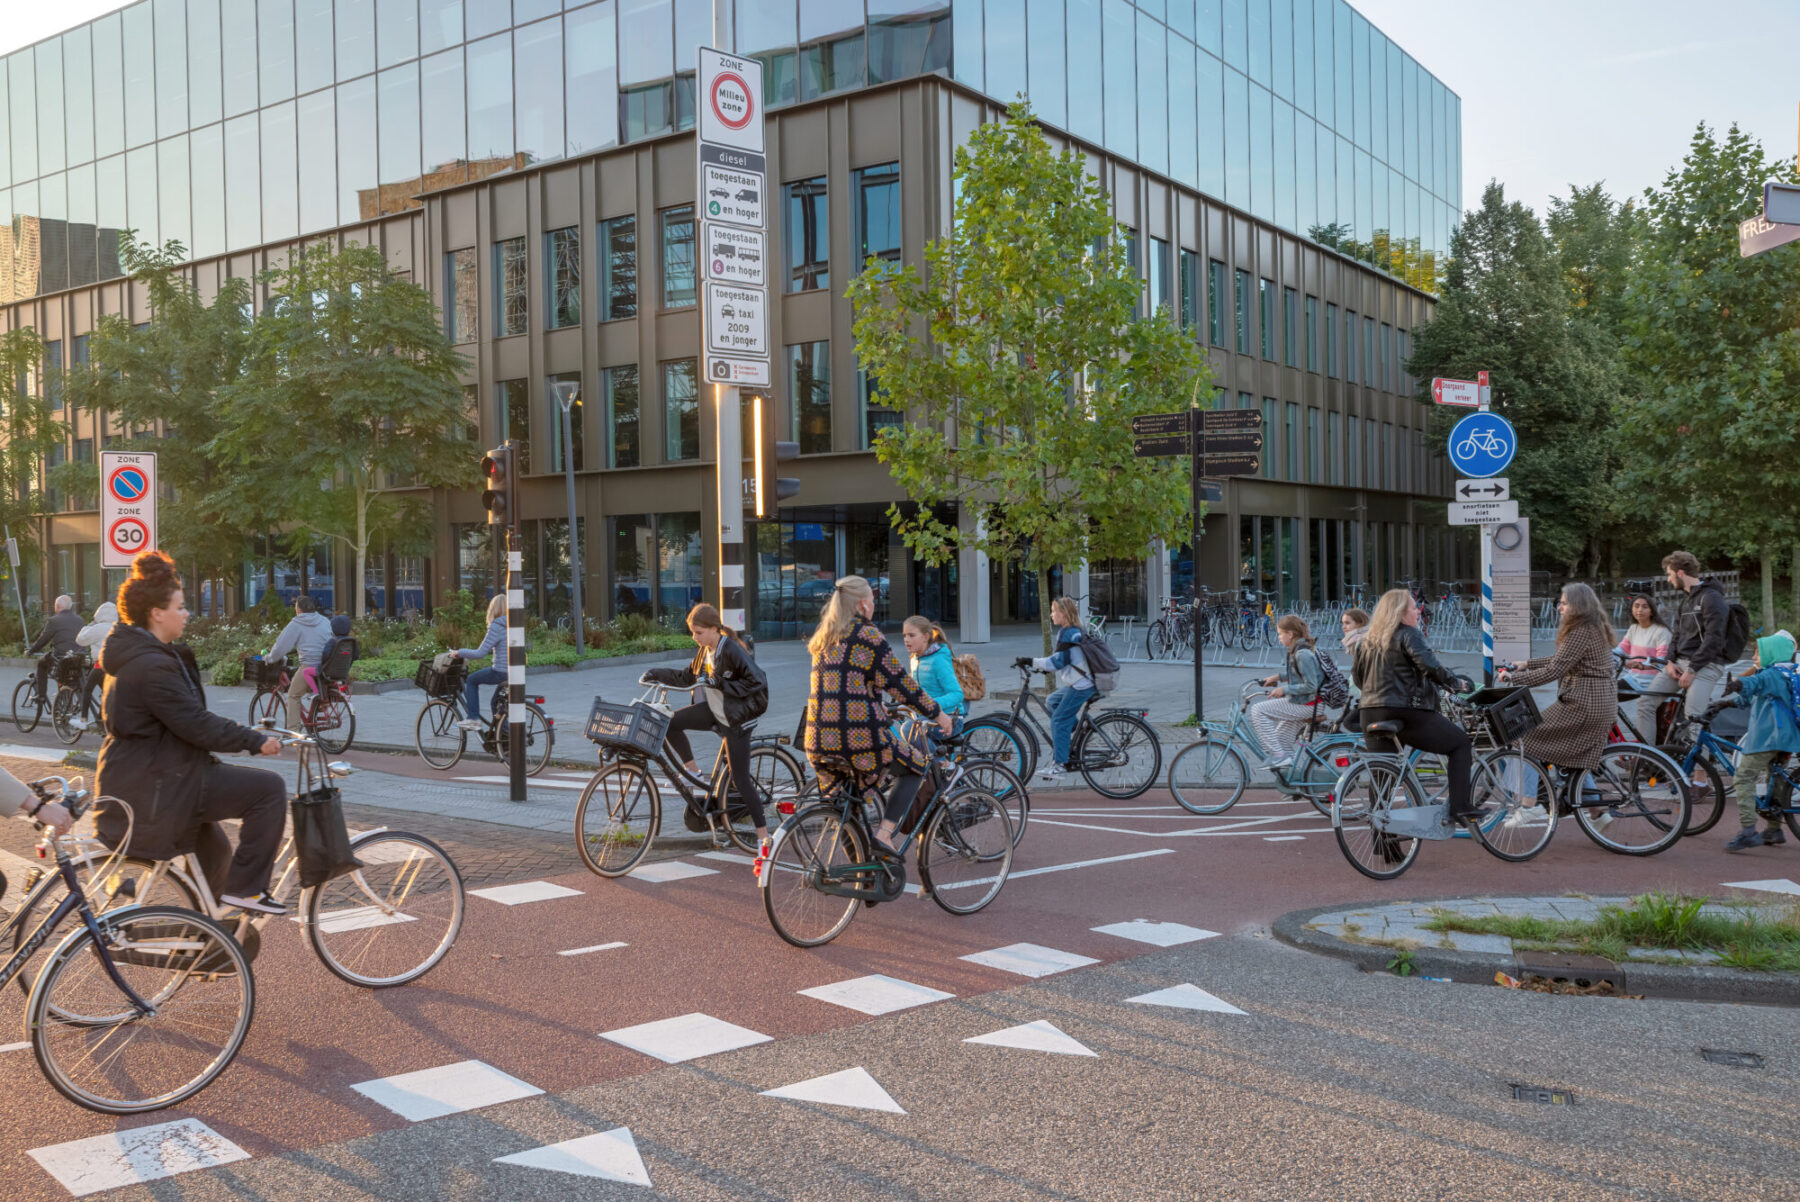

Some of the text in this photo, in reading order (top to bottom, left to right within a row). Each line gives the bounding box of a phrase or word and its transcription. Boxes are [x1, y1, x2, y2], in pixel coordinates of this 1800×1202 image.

[719, 57, 744, 72] ZONE
[718, 88, 745, 103] Milieu
[721, 101, 743, 113] zone
[719, 152, 747, 167] diesel
[710, 170, 756, 187] toegestaan
[711, 203, 759, 220] 4 en hoger
[714, 229, 758, 245] toegestaan
[715, 262, 761, 279] 6 en hoger
[715, 288, 759, 303] toegestaan
[738, 309, 754, 320] taxi
[727, 322, 750, 333] 2009
[720, 333, 757, 347] en jonger
[117, 456, 141, 464] ZONE
[117, 529, 143, 543] 30
